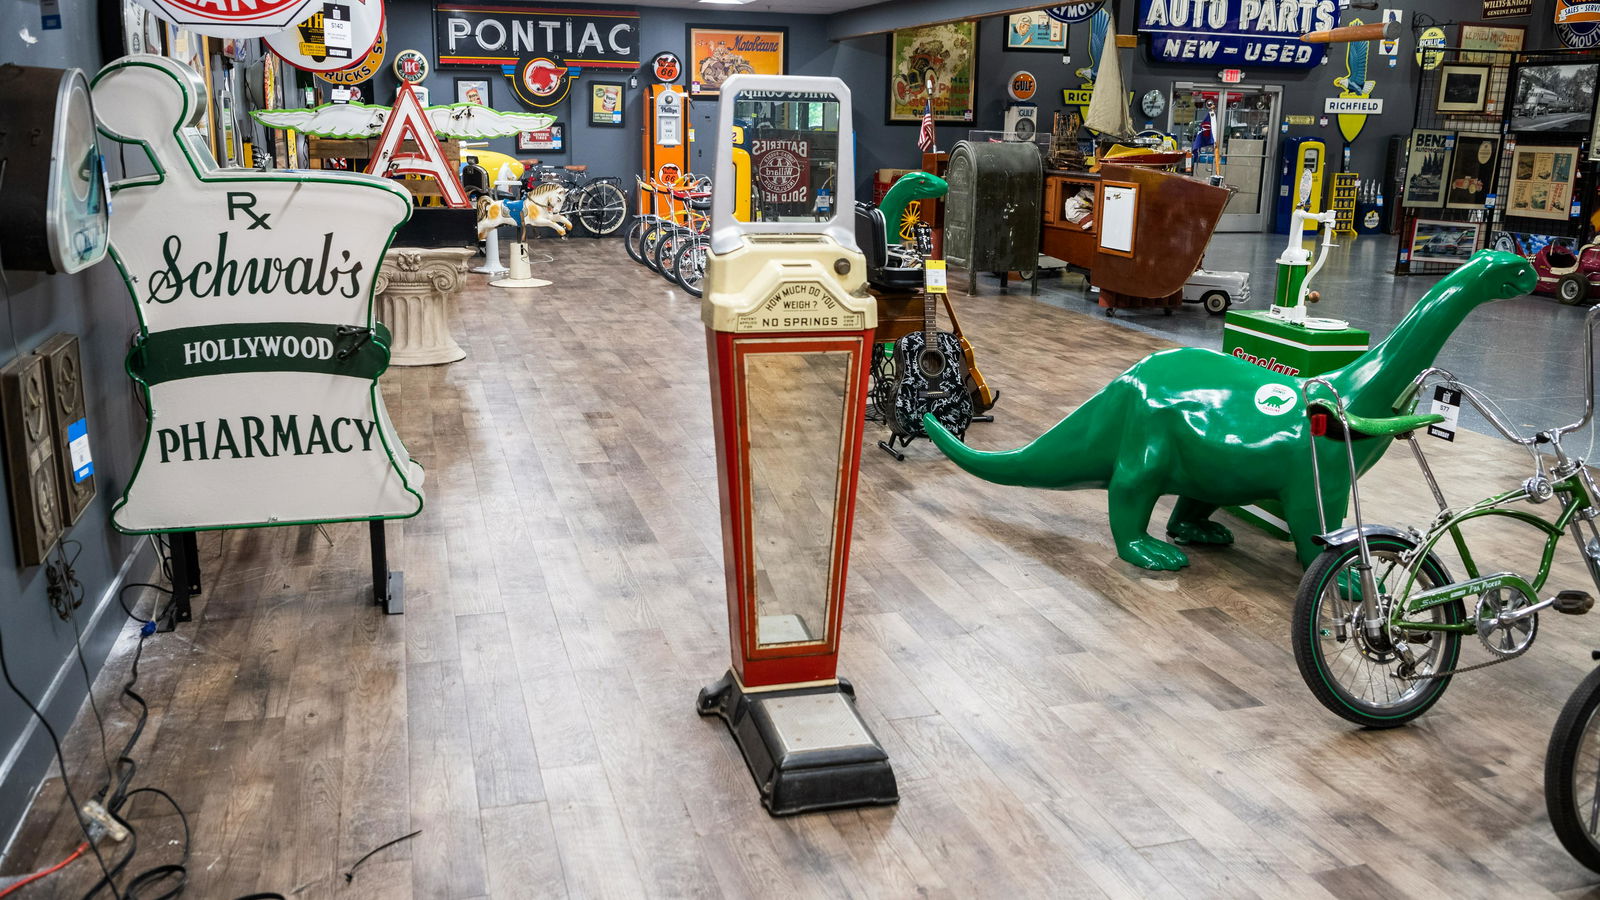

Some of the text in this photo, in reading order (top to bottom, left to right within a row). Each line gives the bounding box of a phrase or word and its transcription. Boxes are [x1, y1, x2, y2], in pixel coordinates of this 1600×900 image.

[1585, 4, 1600, 12] SERVI
[1145, 0, 1336, 34] AUTO PARTS
[448, 18, 631, 55] PONTIAC
[1163, 38, 1220, 59] NEW
[1244, 42, 1312, 63] USED
[323, 65, 371, 83] RUCKS
[660, 67, 673, 77] 66
[1225, 69, 1239, 81] EXIT
[1014, 81, 1033, 91] GULF
[1329, 102, 1379, 110] RICHFIELD
[1416, 134, 1446, 147] BENZ
[665, 174, 675, 182] 66
[146, 232, 363, 304] Schwab's
[766, 285, 835, 311] HOW MUCH DO YOU
[783, 301, 811, 309] WEIGH
[762, 317, 838, 327] NO SPRINGS
[184, 335, 334, 365] HOLLYWOOD
[157, 414, 376, 463] PHARMACY
